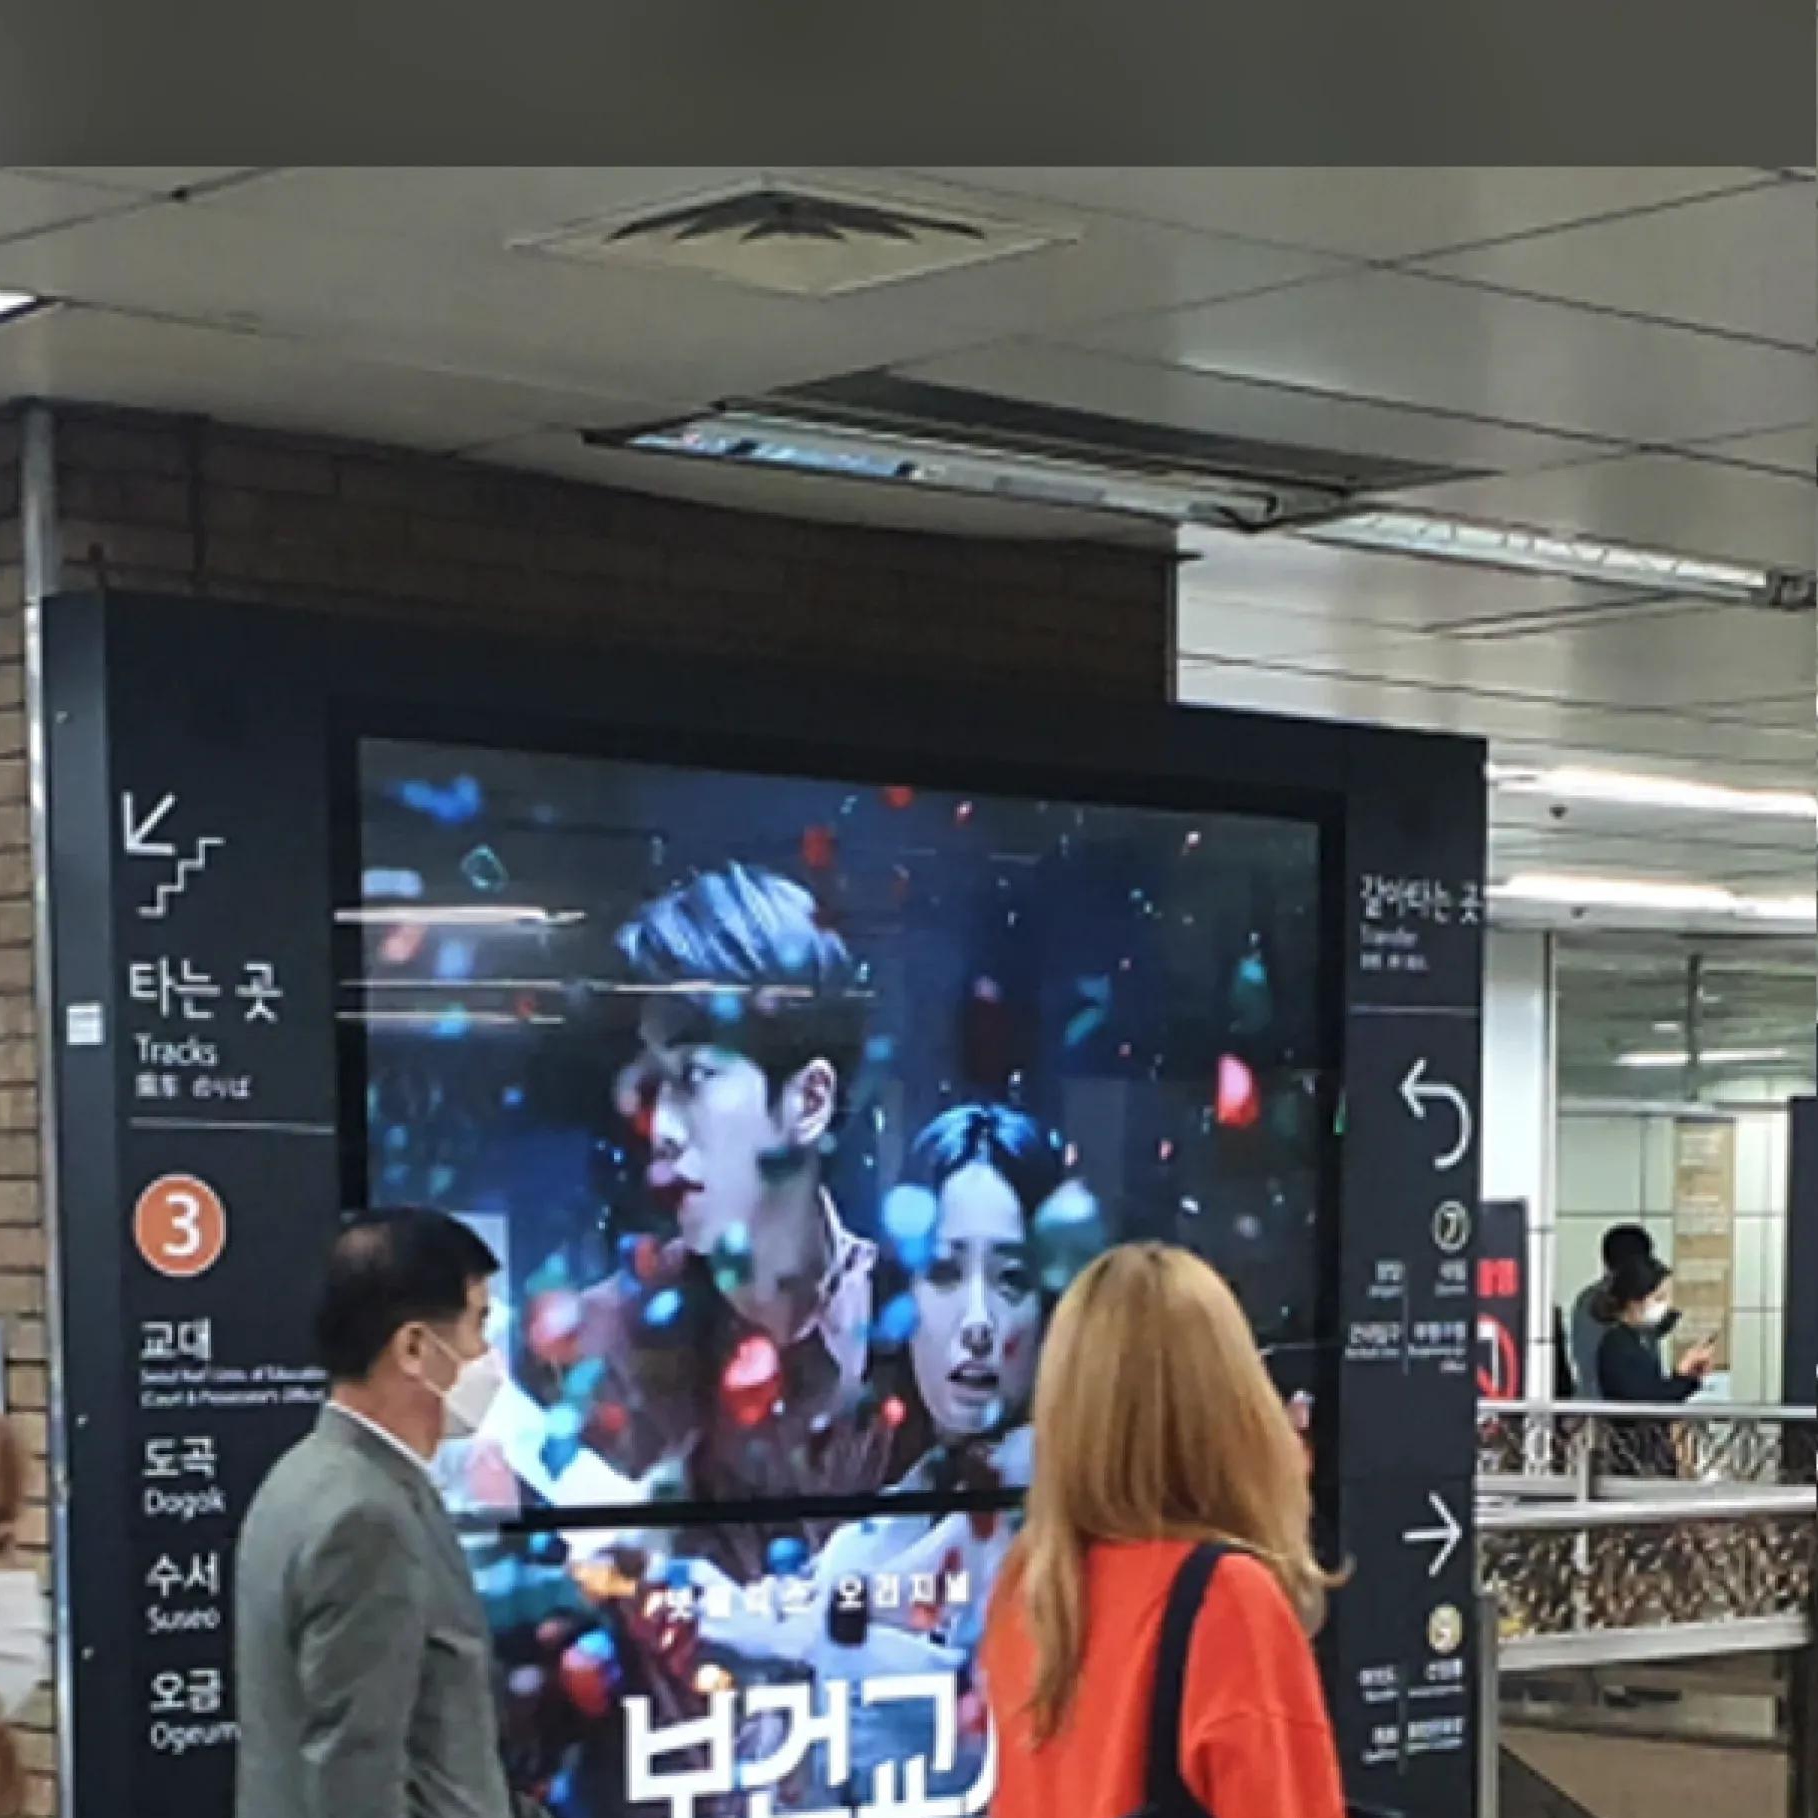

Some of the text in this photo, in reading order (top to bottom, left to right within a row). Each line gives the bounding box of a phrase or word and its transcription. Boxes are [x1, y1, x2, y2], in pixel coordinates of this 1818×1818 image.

[129, 957, 282, 1022] 타는 곳
[135, 1032, 218, 1067] Tracks
[163, 1194, 202, 1257] 3
[140, 1318, 211, 1361] 교대
[142, 1436, 216, 1479] 도곡
[144, 1487, 225, 1518] Dogok
[146, 1552, 218, 1597] 수서
[146, 1606, 220, 1634] Suseo
[150, 1667, 222, 1713] 오금
[150, 1720, 241, 1755] Ogeum
